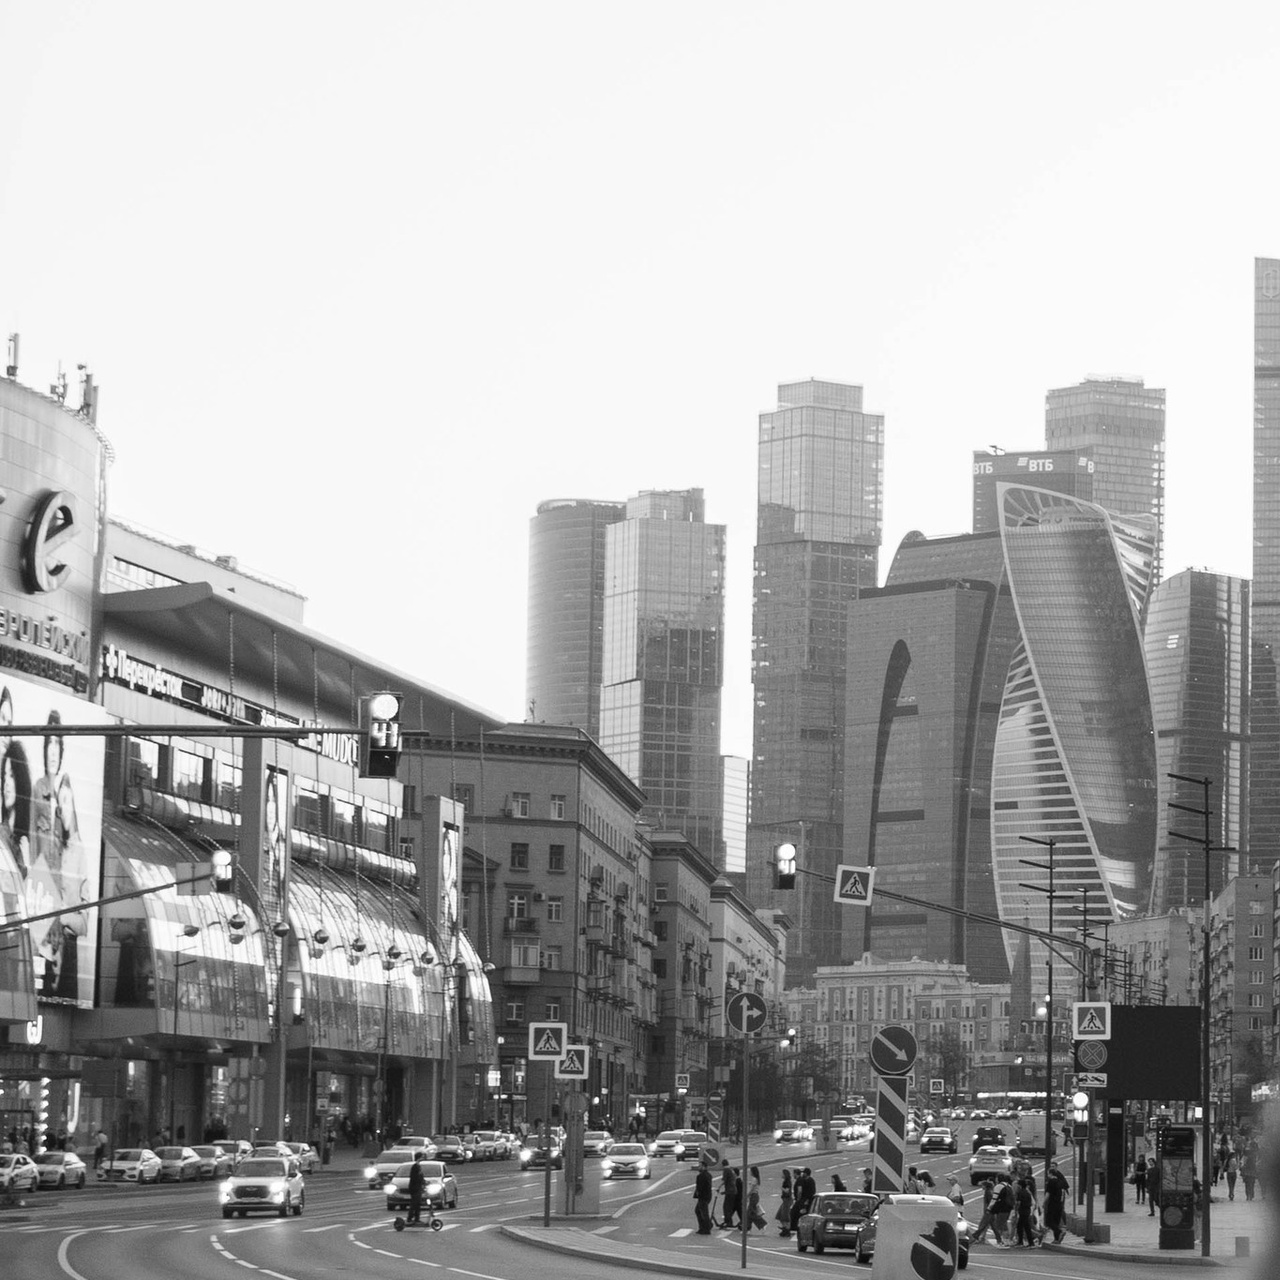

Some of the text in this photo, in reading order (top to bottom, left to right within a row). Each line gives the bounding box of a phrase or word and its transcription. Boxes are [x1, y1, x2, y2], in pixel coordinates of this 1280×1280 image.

[1028, 459, 1054, 471] ВТБ
[118, 649, 183, 699] Перекрёсток
[372, 722, 399, 748] 41
